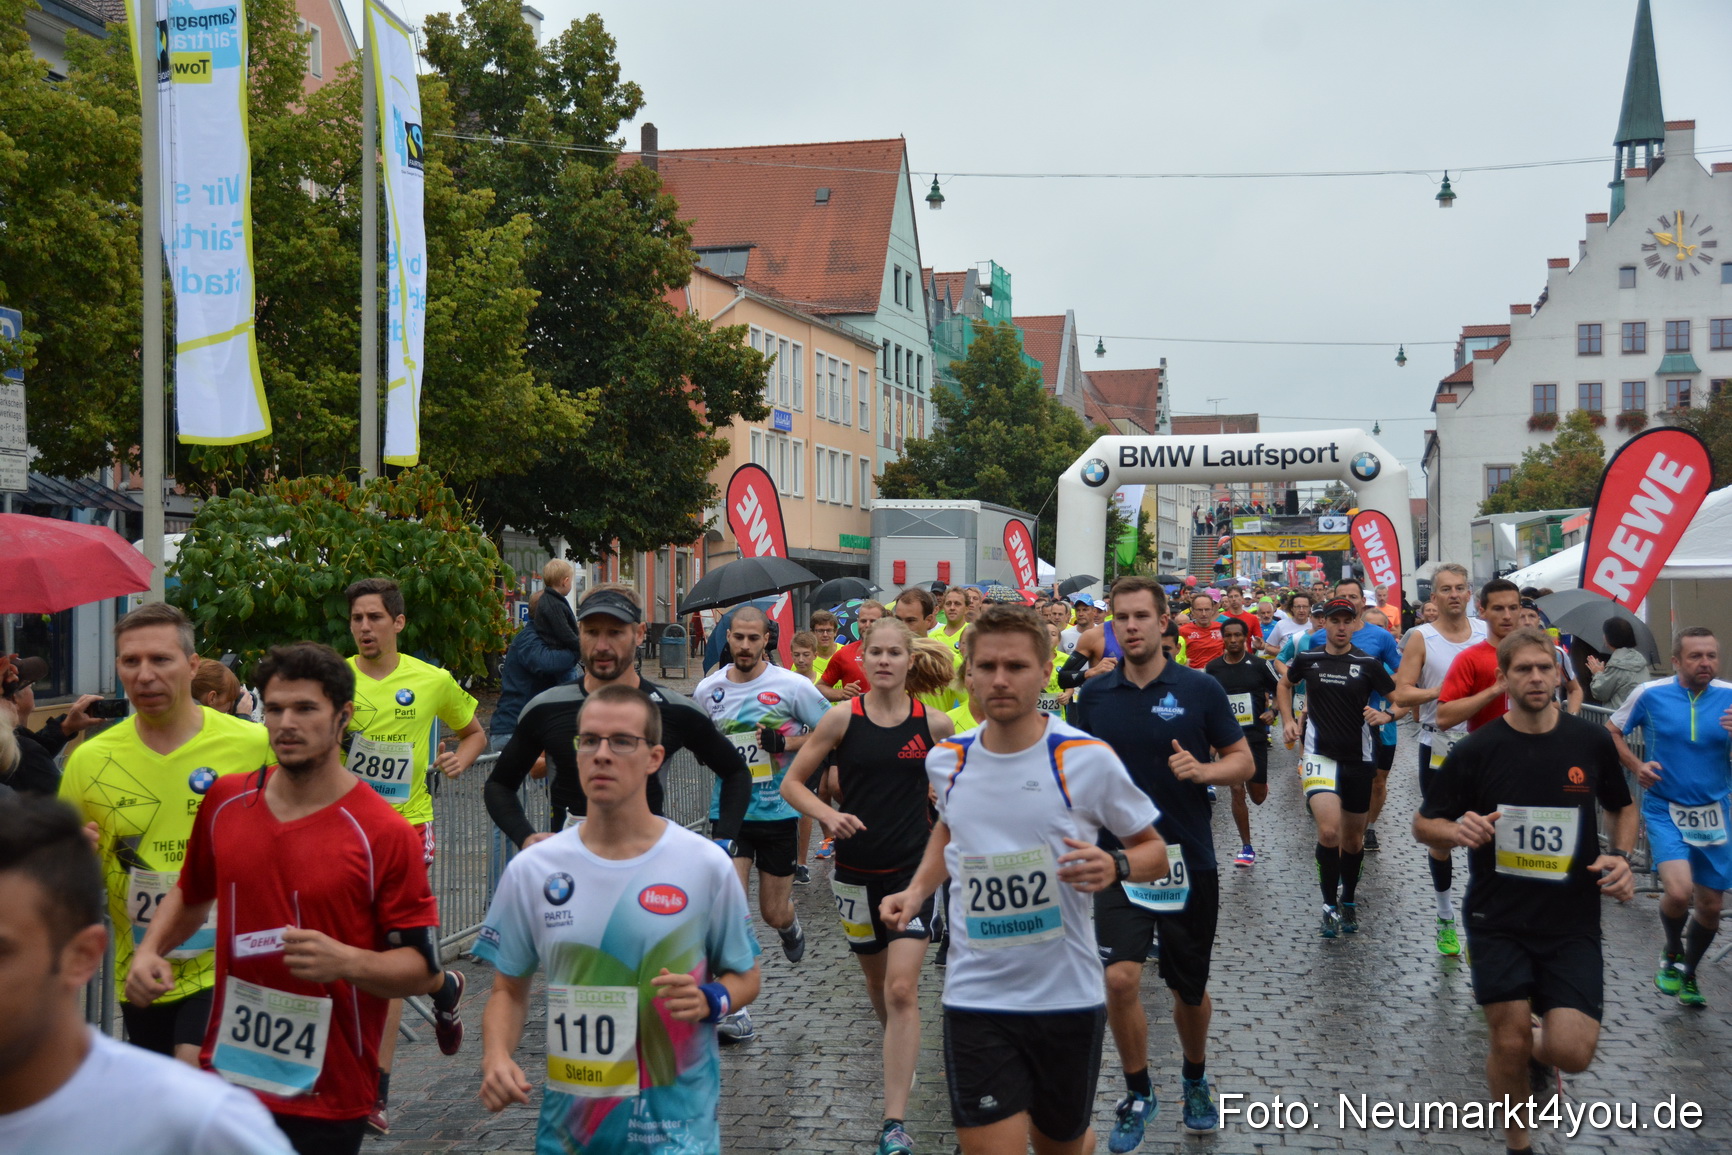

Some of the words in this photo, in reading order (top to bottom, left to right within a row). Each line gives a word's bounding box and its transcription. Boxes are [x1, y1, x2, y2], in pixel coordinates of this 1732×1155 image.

[1119, 445, 1195, 468] BMW
[1202, 442, 1339, 469] Laufsport
[1592, 452, 1694, 602] REWE
[1278, 538, 1305, 549] ZIEL
[387, 734, 407, 742] NEXT
[897, 750, 927, 759] adida
[352, 751, 410, 780] 2897
[1306, 762, 1321, 776] 91
[1676, 810, 1718, 828] 2610
[153, 841, 174, 852] THE
[1513, 824, 1563, 852] 163
[164, 851, 183, 863] 100
[993, 850, 1043, 867] BOCK
[1516, 855, 1558, 870] Thomas
[645, 890, 683, 907] Hervis
[969, 870, 1050, 912] 2862
[1132, 889, 1181, 901] Maximilian
[545, 910, 574, 921] PARTL
[980, 916, 1044, 936] Christoph
[250, 936, 277, 949] DEHN
[268, 992, 321, 1013] BOCK
[575, 990, 627, 1004] BOCK
[231, 1004, 317, 1059] 3024
[554, 1012, 615, 1055] 110
[565, 1063, 603, 1082] Stefan
